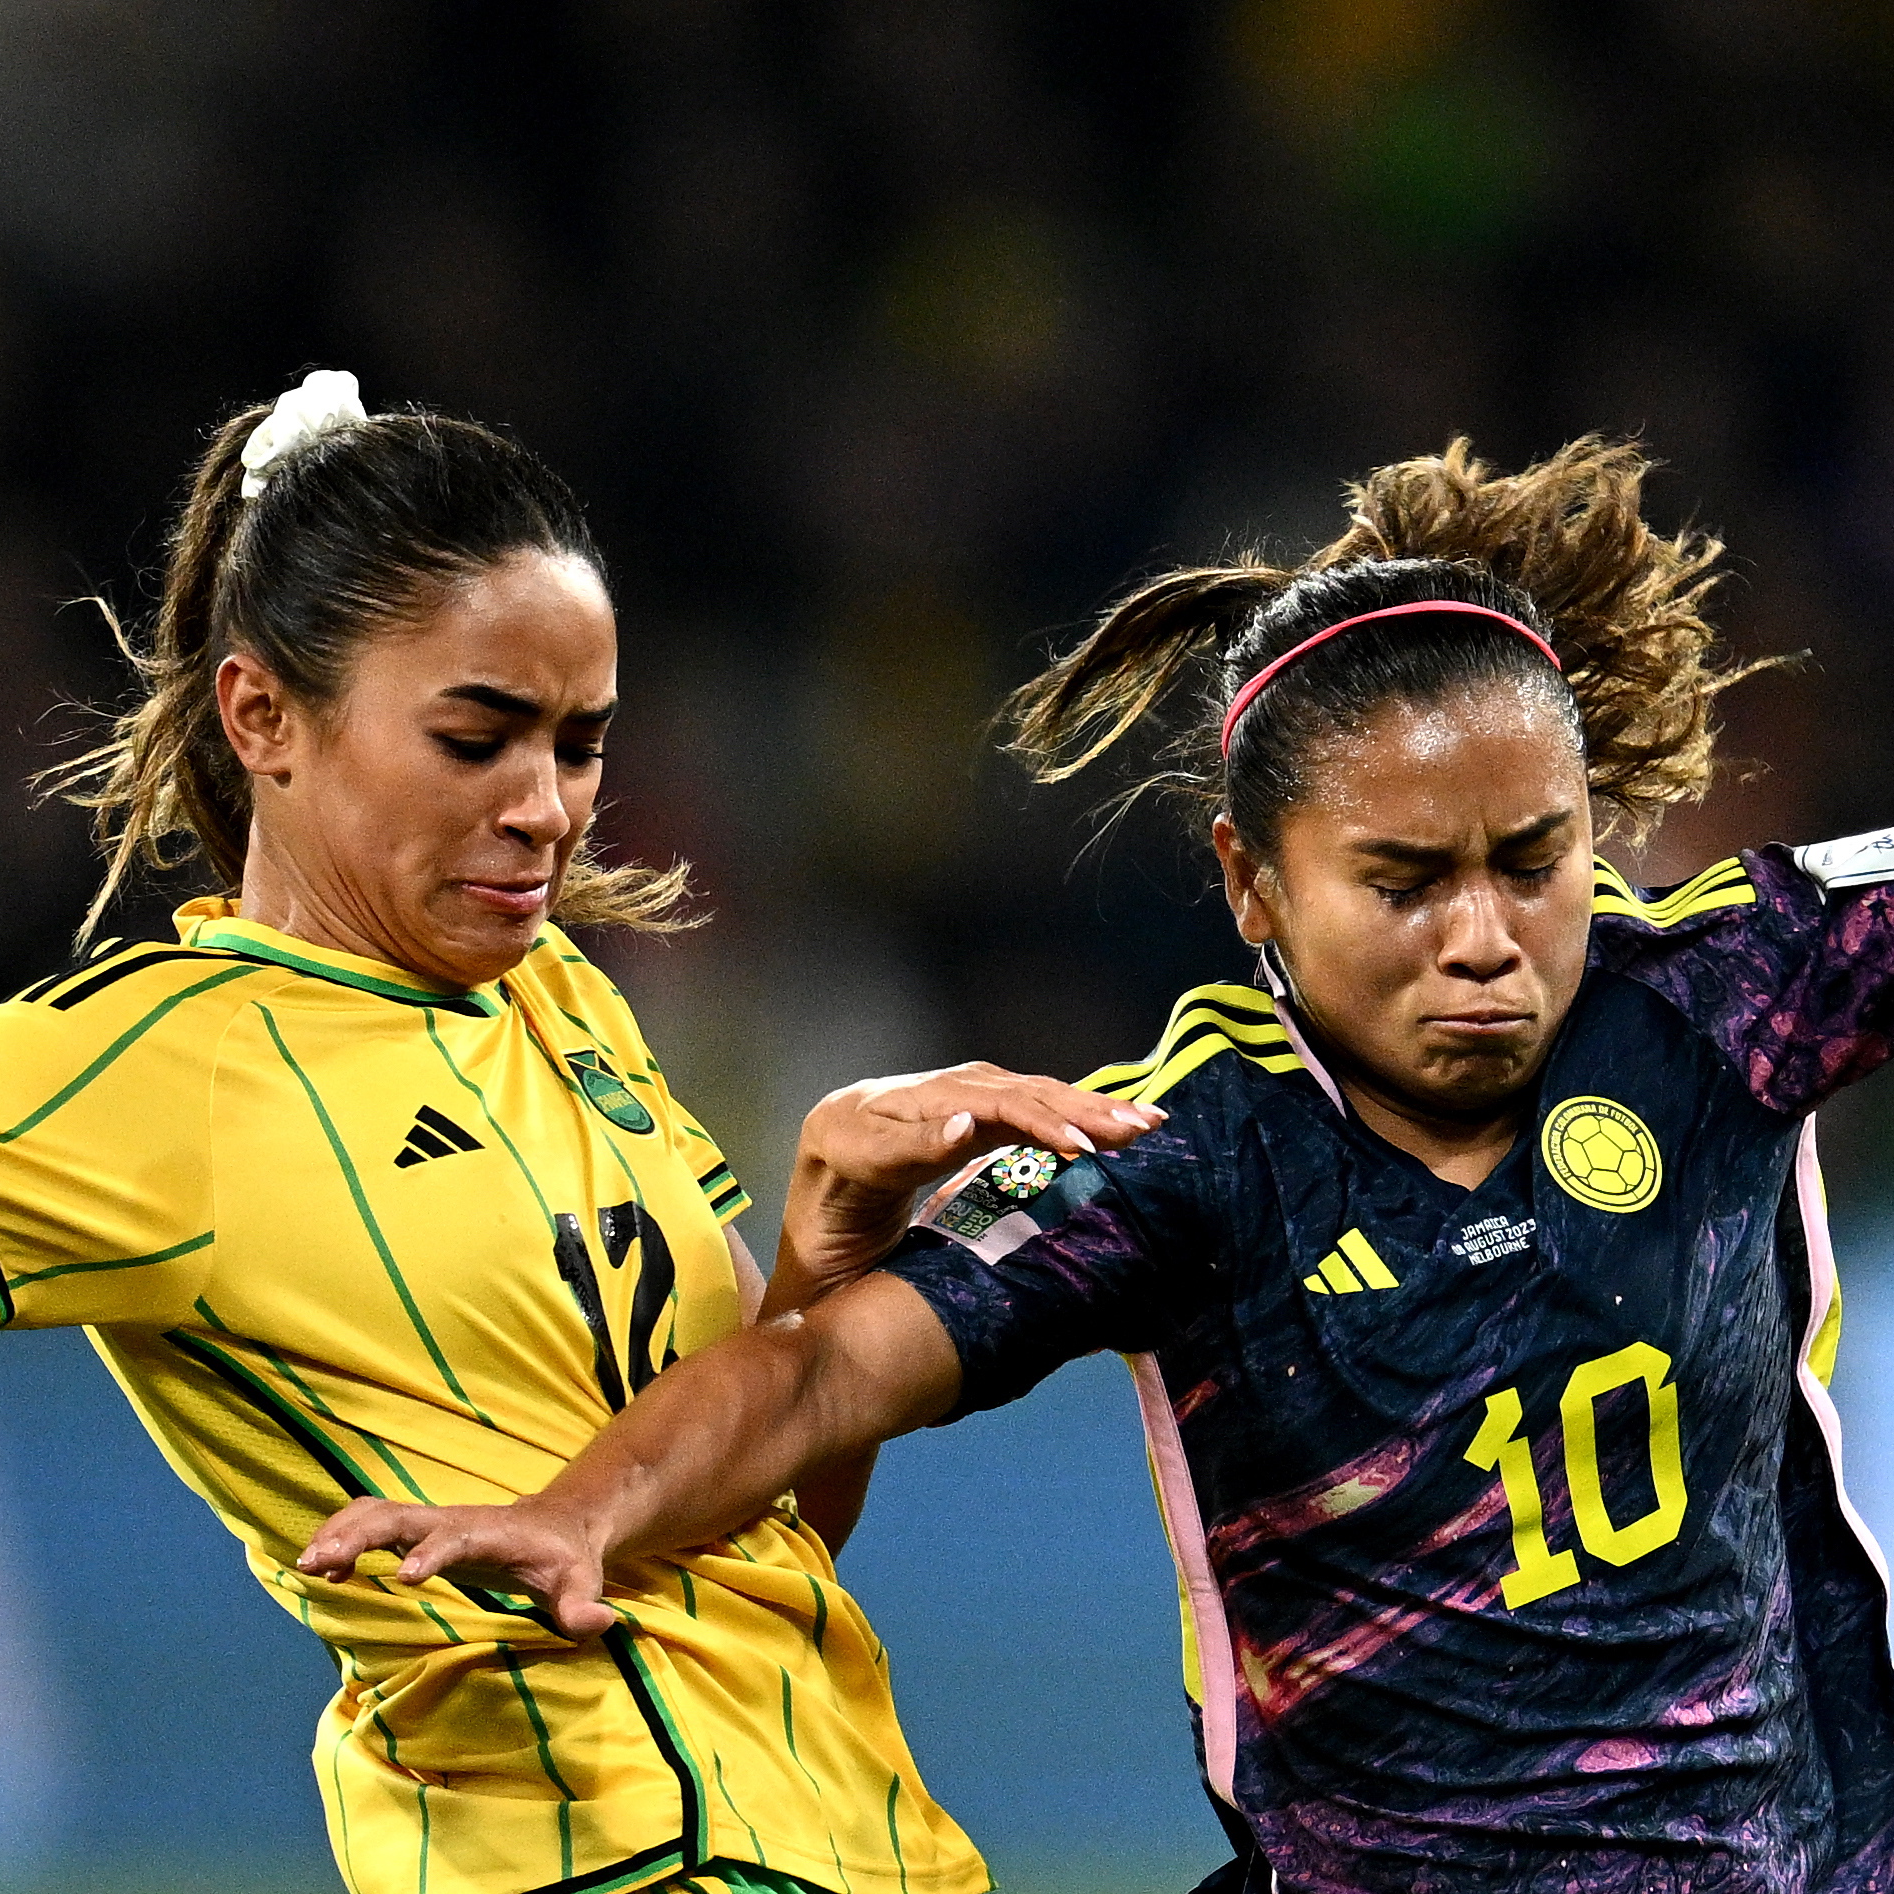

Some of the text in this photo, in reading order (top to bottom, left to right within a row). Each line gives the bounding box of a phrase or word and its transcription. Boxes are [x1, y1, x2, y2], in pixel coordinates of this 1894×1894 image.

[957, 1221, 982, 1237] 23
[968, 1209, 993, 1226] 20
[1460, 1215, 1510, 1240] JAMAICA
[1463, 1229, 1506, 1253] AUGUST
[1505, 1218, 1537, 1240] 2023
[1468, 1237, 1531, 1266] MELBOURNE
[553, 1200, 679, 1414] 12
[1464, 1341, 1689, 1610] 10
